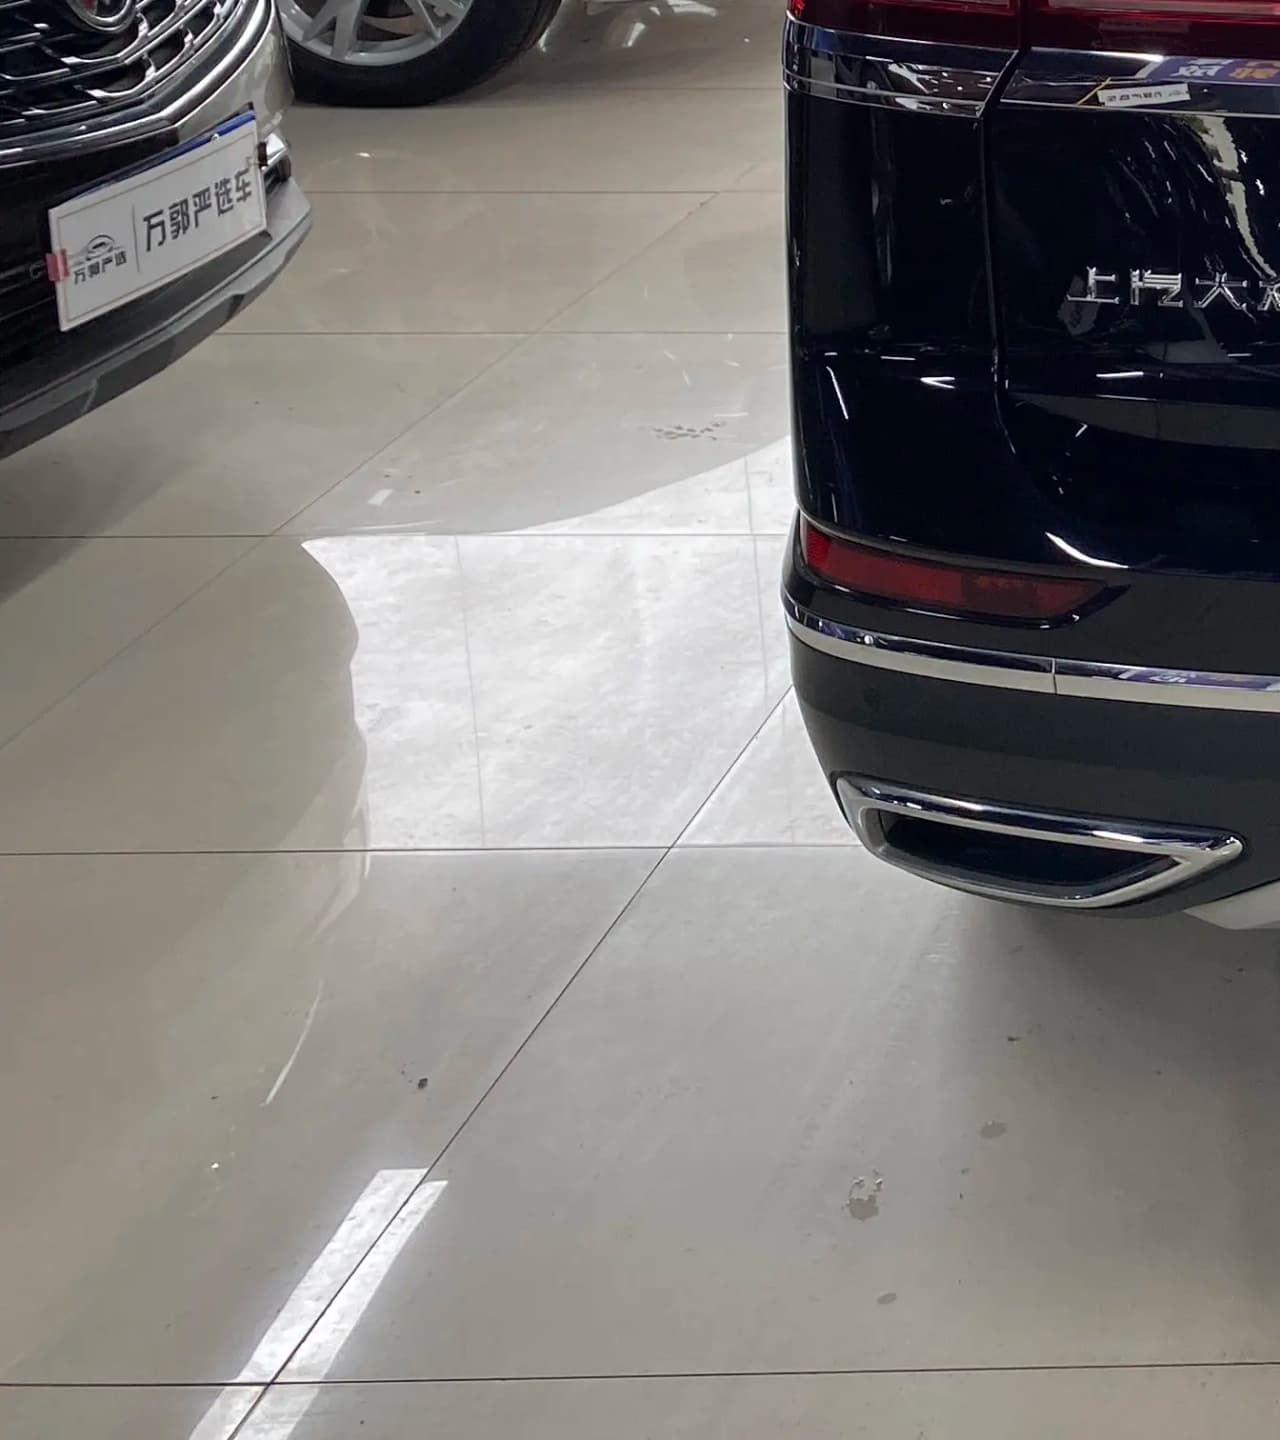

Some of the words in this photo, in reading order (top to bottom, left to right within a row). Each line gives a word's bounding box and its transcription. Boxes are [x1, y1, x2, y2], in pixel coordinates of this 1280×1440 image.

[143, 167, 252, 252] 万郭严选车
